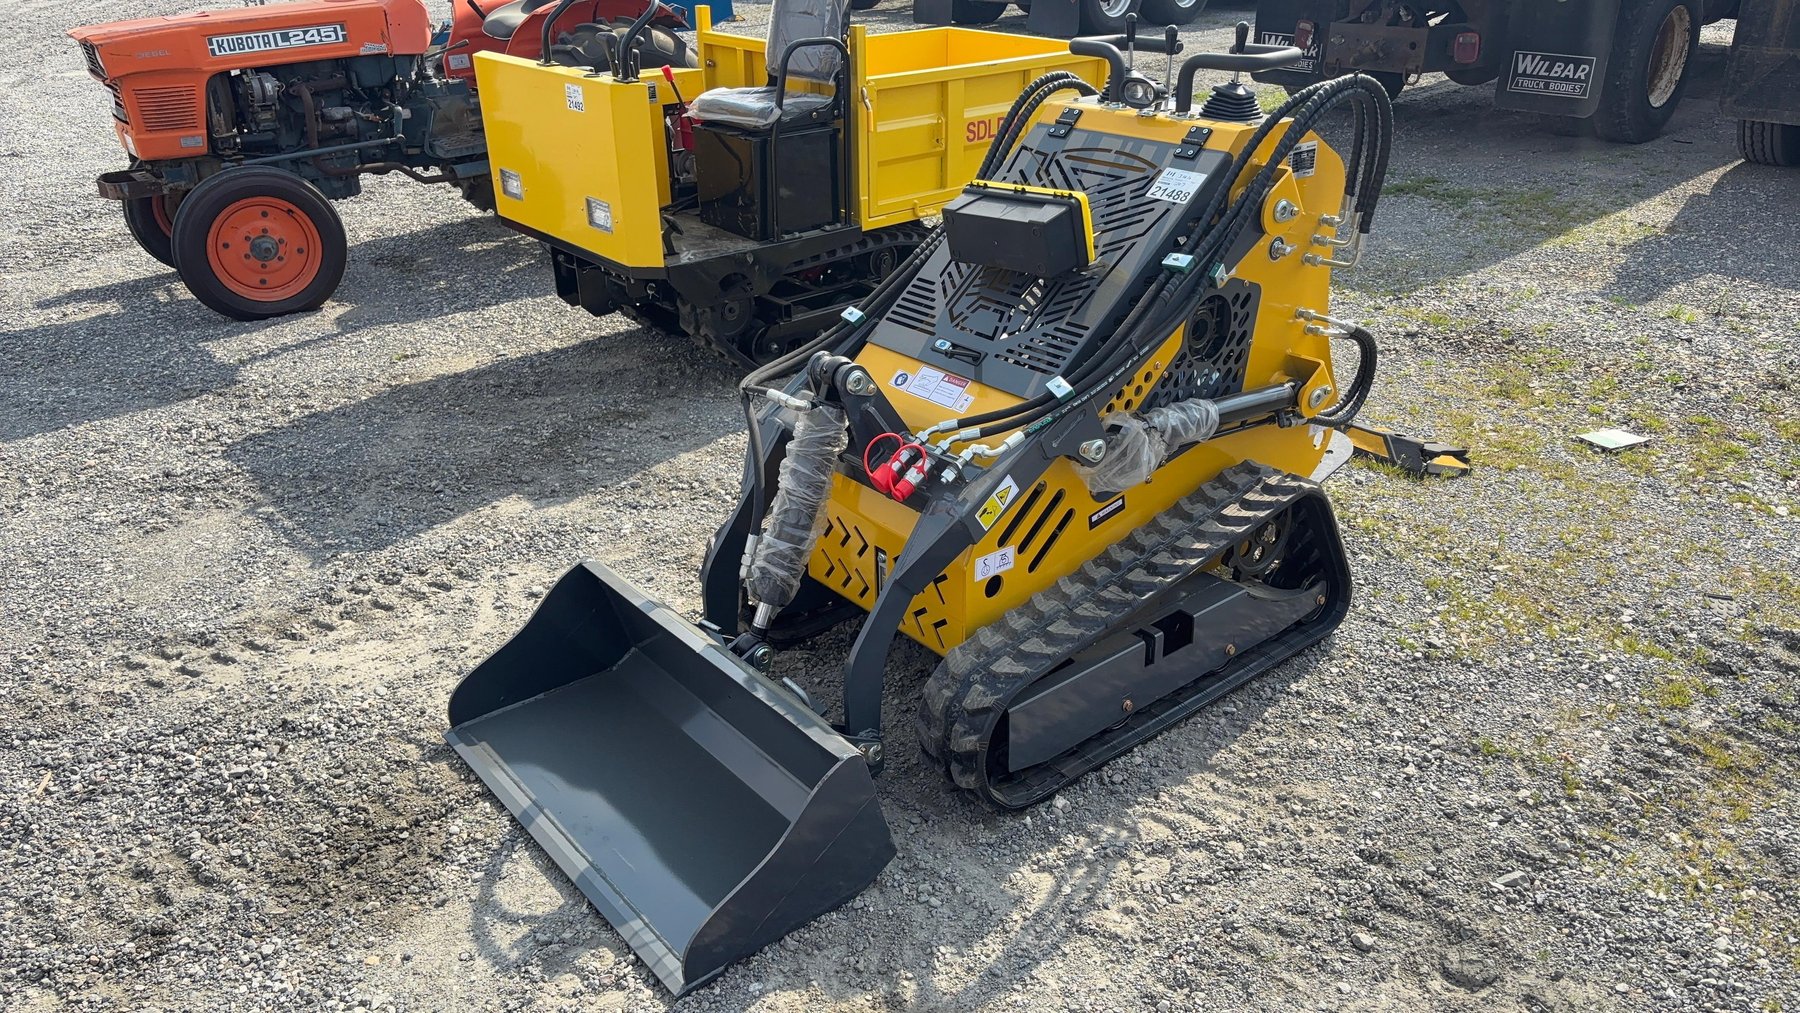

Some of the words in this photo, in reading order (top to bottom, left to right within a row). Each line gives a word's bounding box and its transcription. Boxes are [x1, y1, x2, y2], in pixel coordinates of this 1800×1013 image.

[216, 34, 272, 54] KUBOTA
[275, 28, 337, 47] L245
[1517, 79, 1545, 89] TRUCK
[1548, 82, 1581, 93] BODIES
[567, 99, 584, 112] 21492
[1150, 185, 1191, 202] 21488
